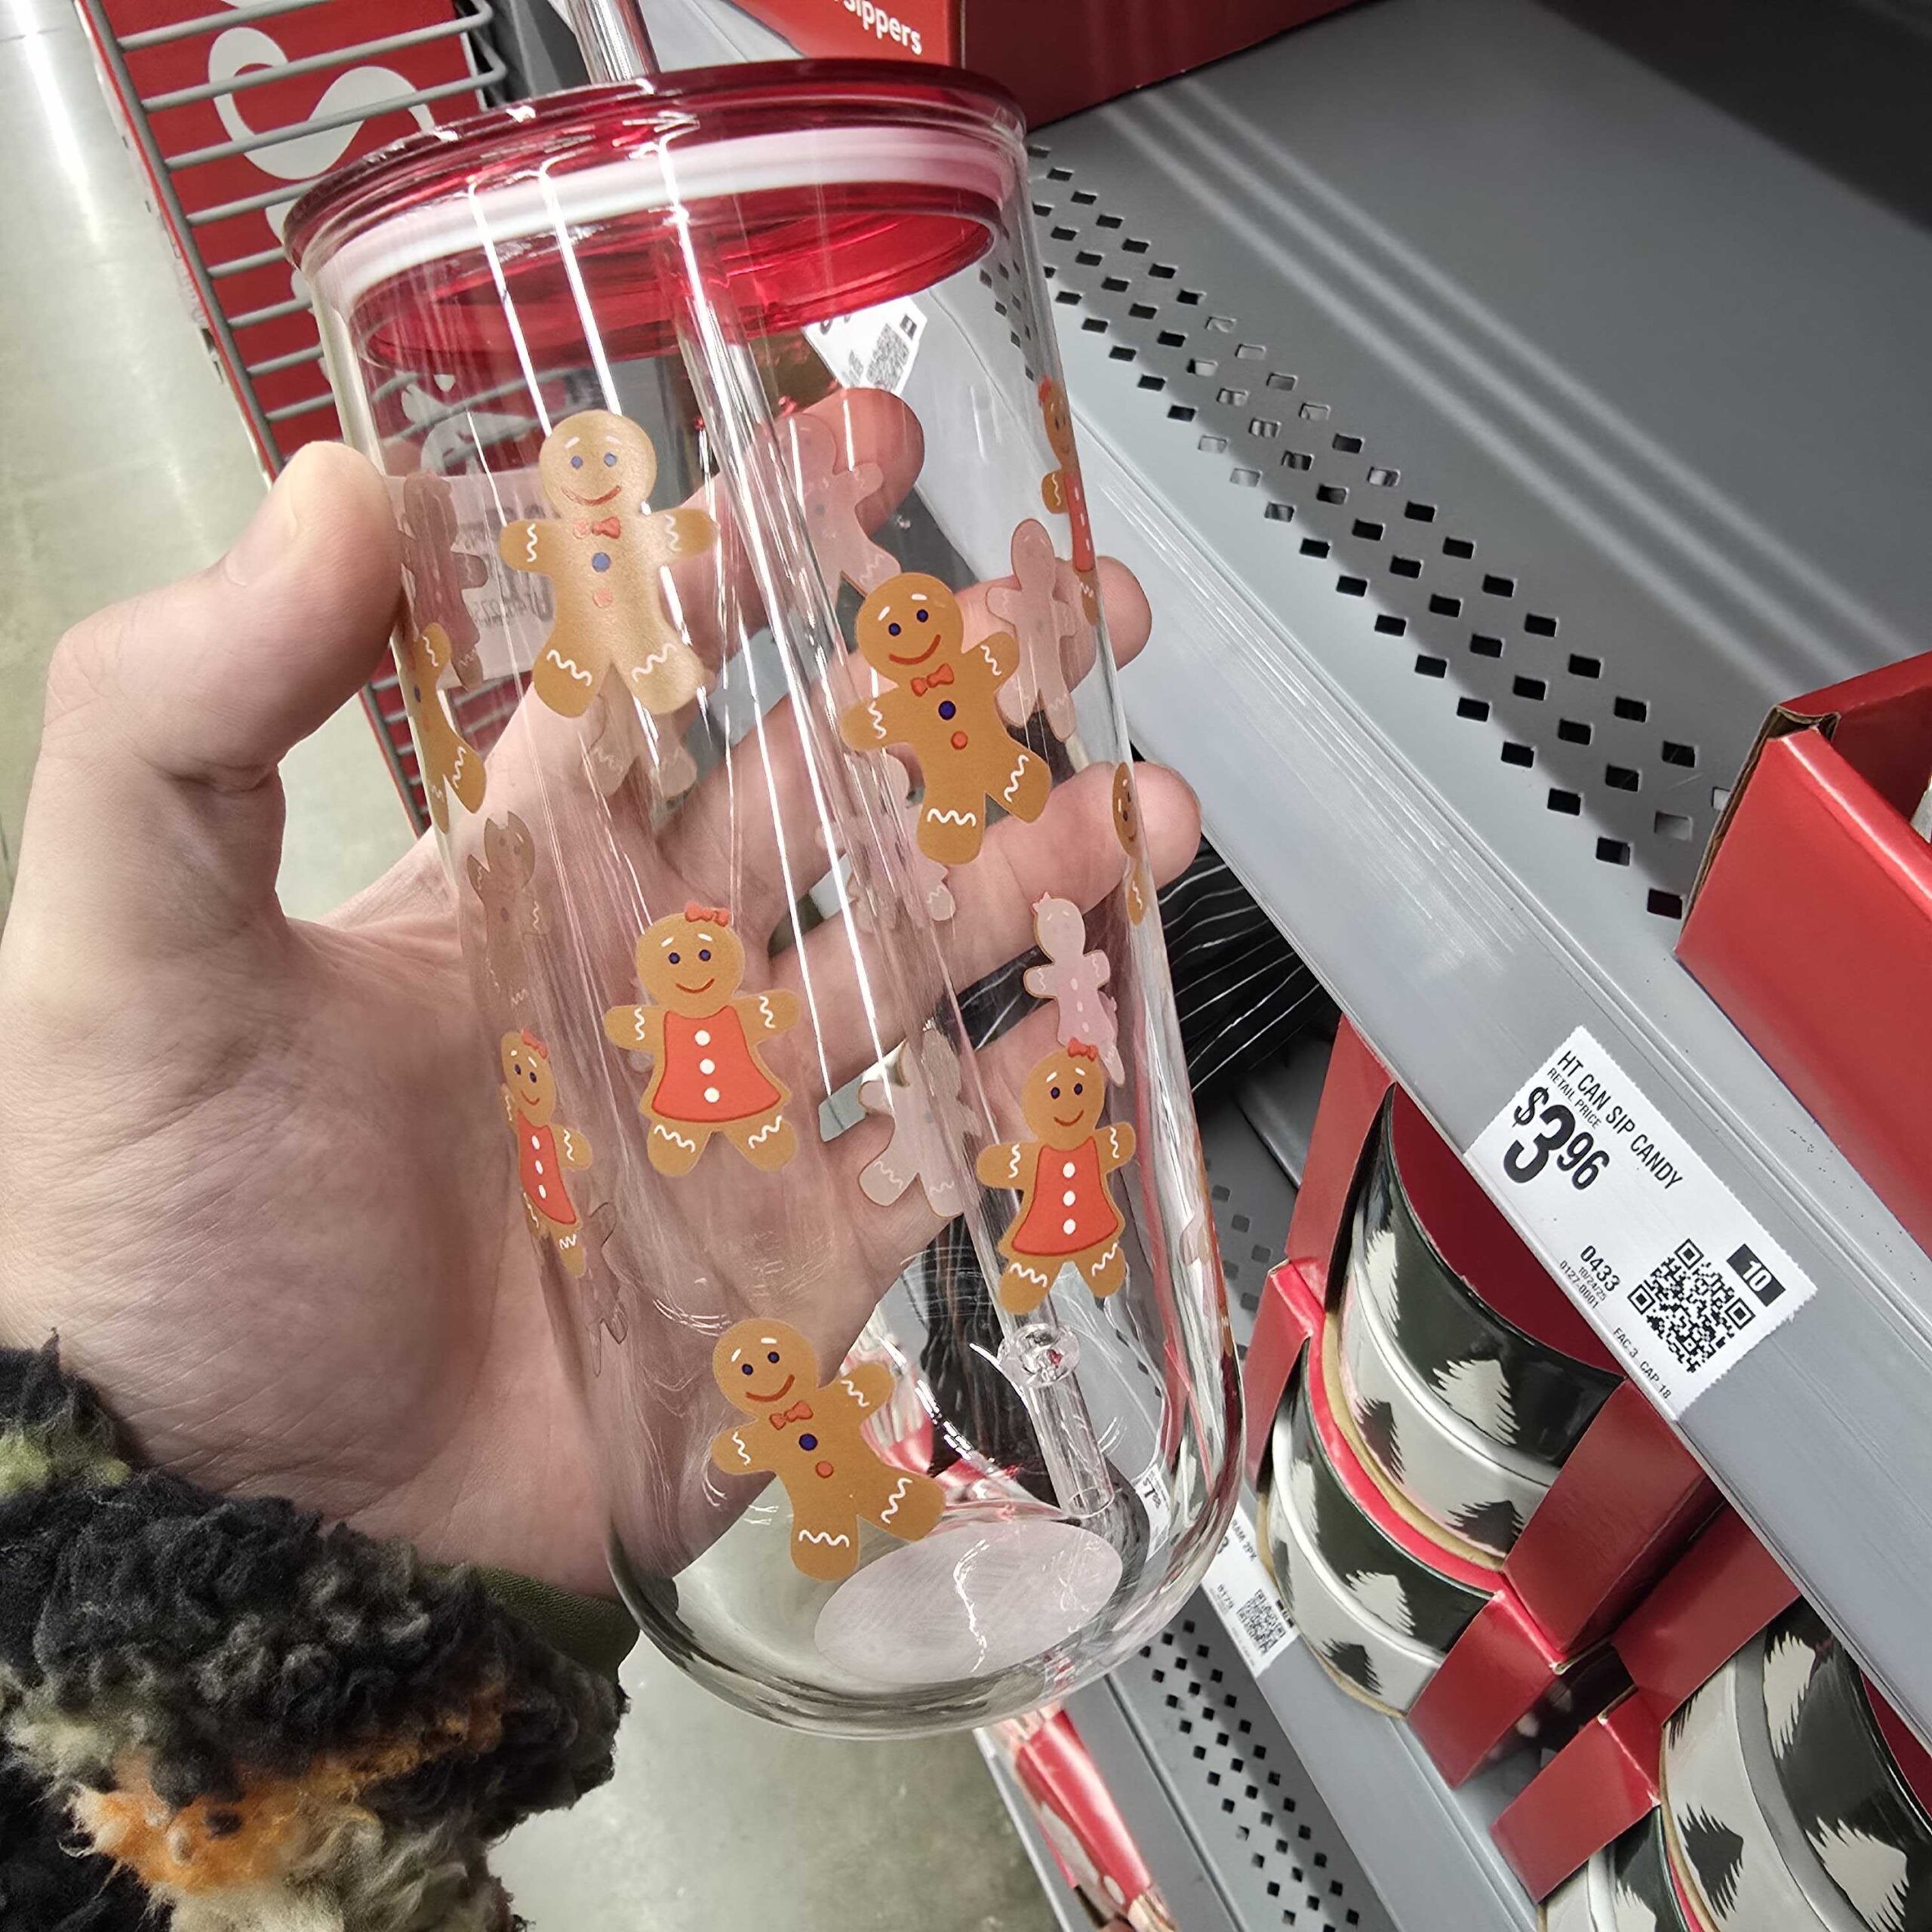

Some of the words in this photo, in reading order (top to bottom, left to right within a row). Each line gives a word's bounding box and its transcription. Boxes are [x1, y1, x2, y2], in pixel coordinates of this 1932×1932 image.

[1546, 1067, 1576, 1103] RETAIL
[1574, 1098, 1602, 1130] PRICE
[1557, 1050, 1584, 1078] HT
[1577, 1073, 1612, 1111] CAN
[1605, 1105, 1635, 1134] SIP
[1630, 1134, 1683, 1189] CANDY
[1559, 1260, 1599, 1309] 0127-0001
[1580, 1244, 1621, 1292] 0433
[1742, 1260, 1773, 1292] 10
[1613, 1327, 1631, 1349] FAC
[1629, 1347, 1638, 1358] 3
[1639, 1361, 1660, 1383] CAP
[1658, 1383, 1672, 1407] 18
